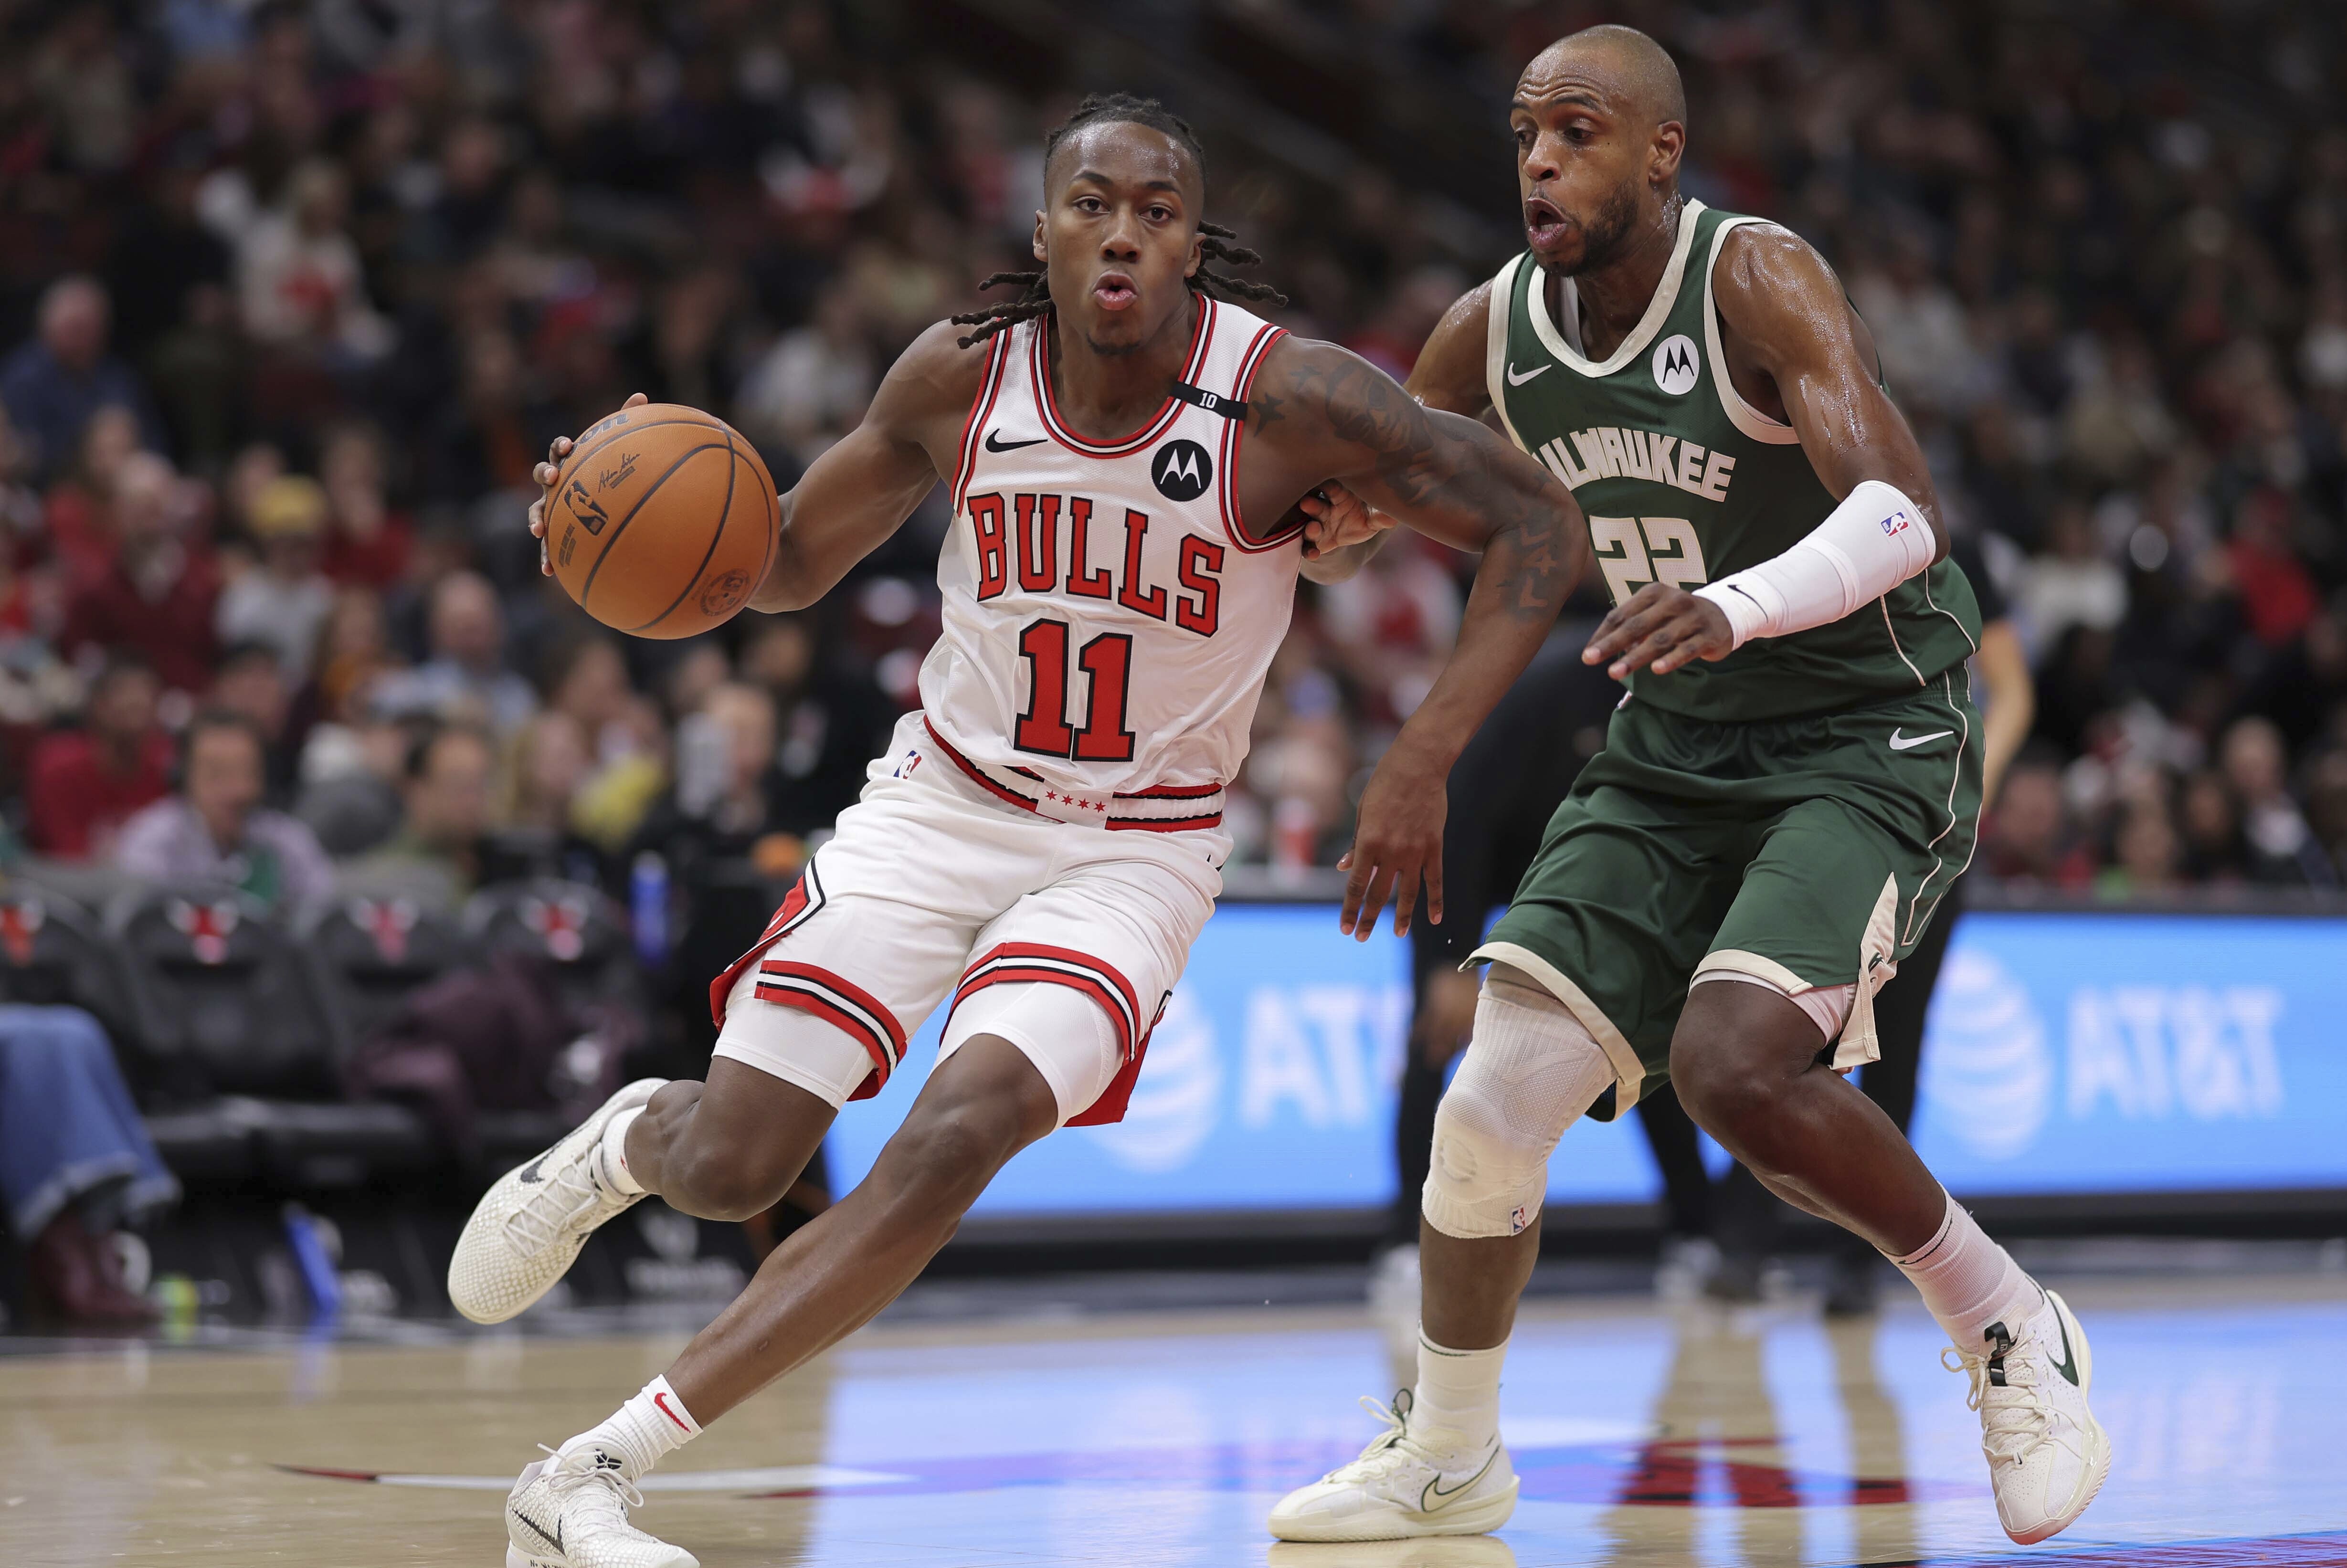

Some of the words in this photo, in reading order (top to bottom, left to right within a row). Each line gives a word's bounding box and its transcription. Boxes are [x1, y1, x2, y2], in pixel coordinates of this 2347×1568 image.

[1199, 392, 1217, 409] 10
[1532, 427, 1736, 503] ILWAUKEE
[967, 492, 1225, 638] BULLS
[1589, 515, 1708, 610] 22
[1014, 618, 1136, 762] 11
[2067, 984, 2285, 1119] AT&T
